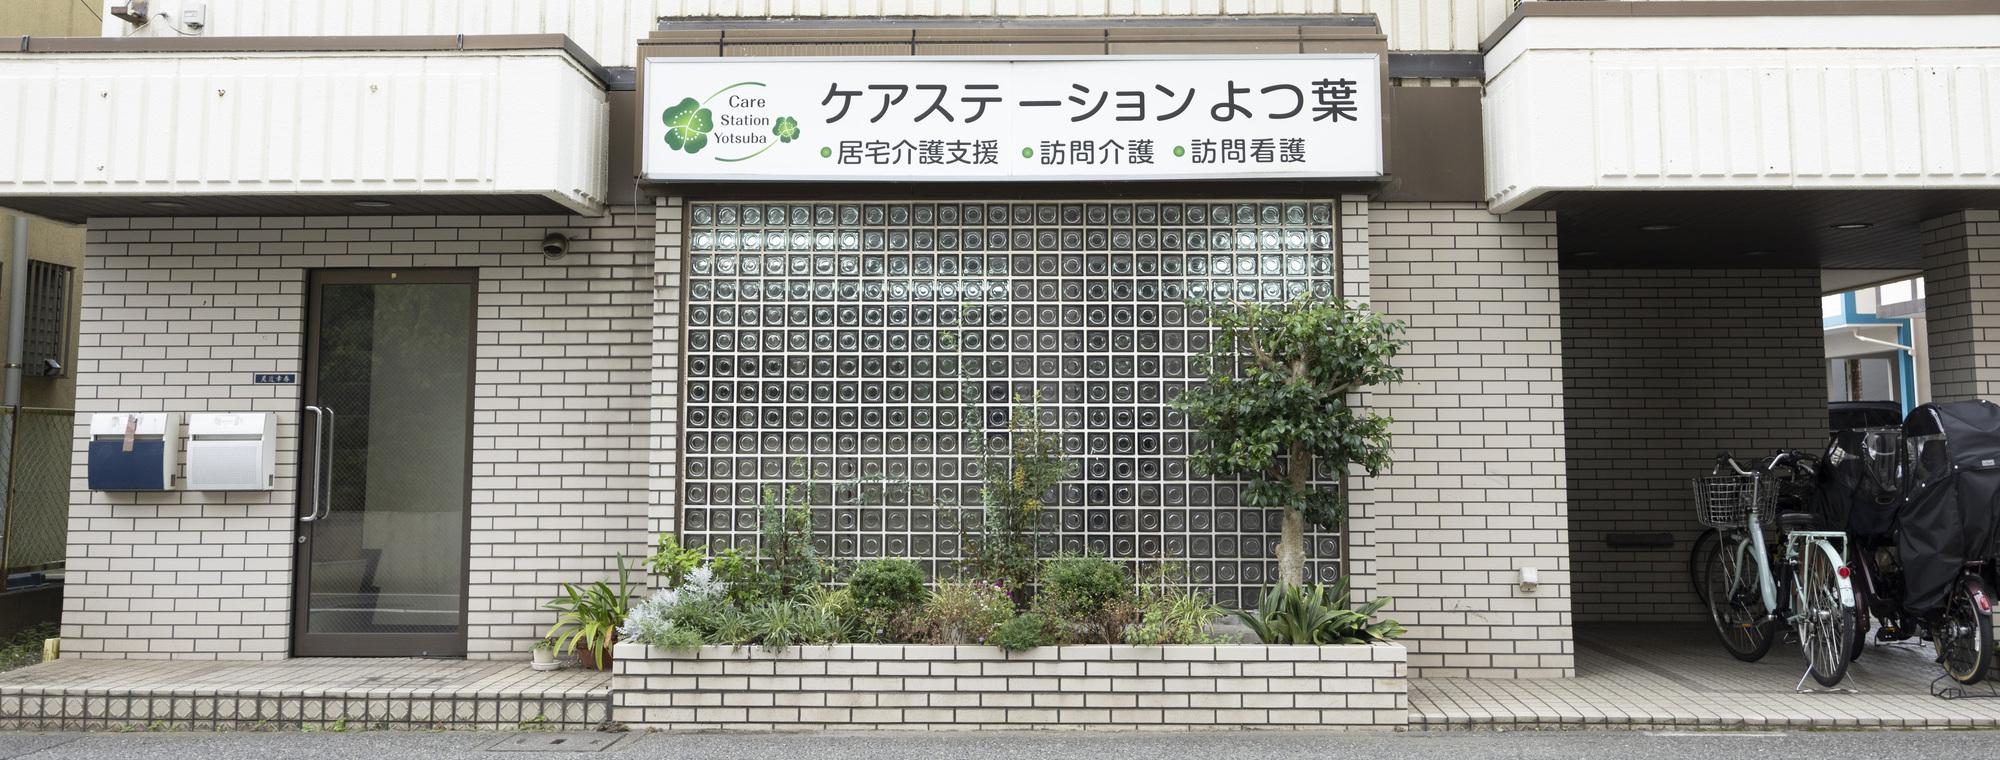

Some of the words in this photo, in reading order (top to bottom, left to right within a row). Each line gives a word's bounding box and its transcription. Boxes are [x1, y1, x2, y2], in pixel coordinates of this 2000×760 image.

[728, 95, 766, 108] Care
[821, 82, 1196, 124] ケアステーション
[1210, 78, 1358, 123] よつ葉
[720, 114, 769, 126] Station
[714, 132, 767, 144] Yotsuba
[837, 139, 999, 165] 居宅介護支援
[1040, 138, 1155, 165] 訪問介護
[1190, 137, 1306, 164] 訪問看護
